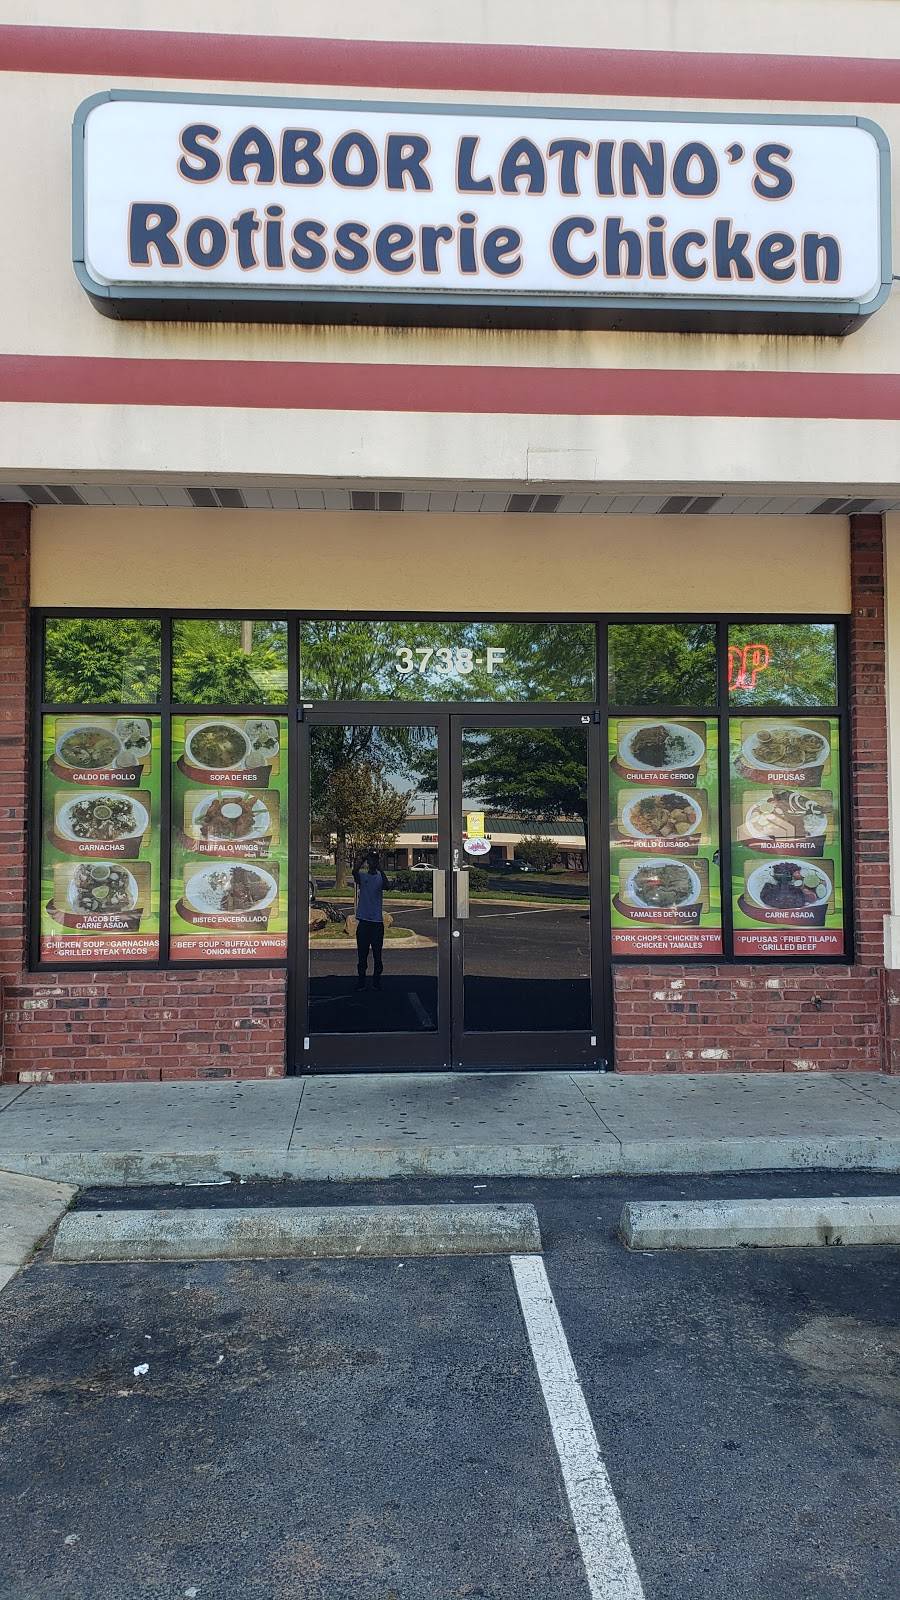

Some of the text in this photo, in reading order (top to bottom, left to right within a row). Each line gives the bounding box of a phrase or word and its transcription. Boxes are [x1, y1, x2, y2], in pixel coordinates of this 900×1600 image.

[177, 122, 434, 193] SABOR
[128, 201, 842, 284] Rotisserie Chicken
[396, 647, 506, 674] 3738-F
